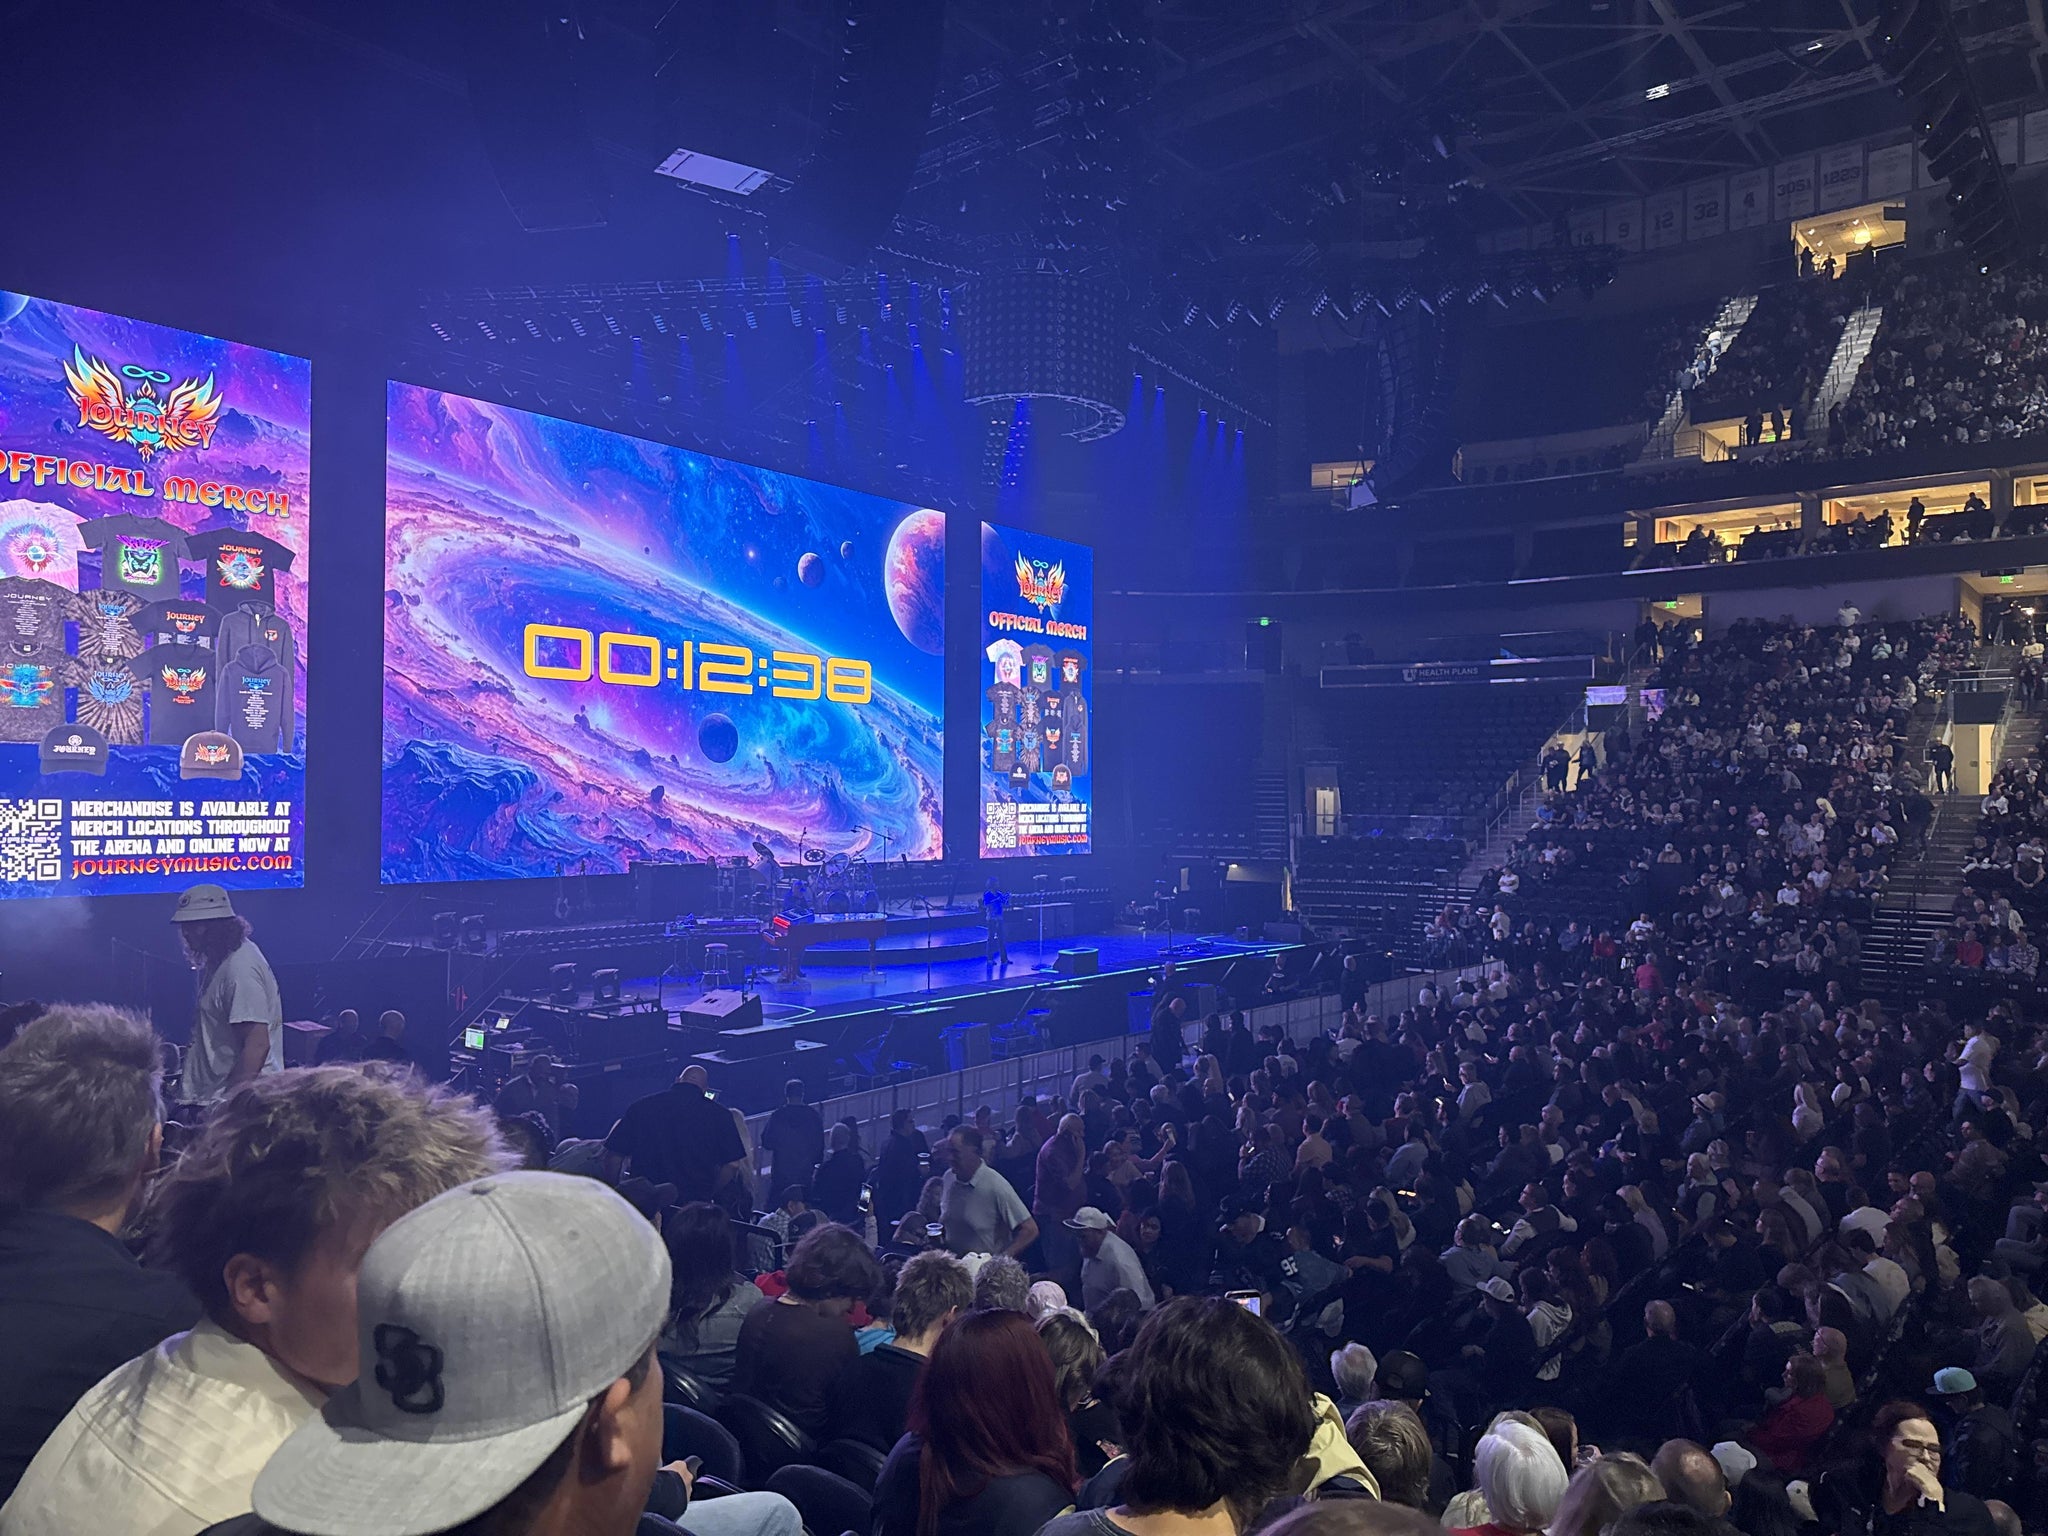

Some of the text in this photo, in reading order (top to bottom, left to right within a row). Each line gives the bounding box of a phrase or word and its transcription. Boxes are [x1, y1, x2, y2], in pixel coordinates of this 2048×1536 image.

[1693, 200, 1719, 221] 32
[1653, 211, 1674, 232] 12
[76, 396, 217, 449] JOURNEY
[164, 475, 290, 518] MERCH
[3, 593, 52, 601] JOURNEY
[166, 611, 205, 624] JOURNEY
[989, 611, 1087, 640] OFFICIAL MERCH
[524, 623, 872, 704] 00:12:38
[1419, 667, 1450, 677] HEALTH
[1451, 666, 1479, 676] PLANS
[71, 801, 291, 817] MERCHANDISE IS AVAILABLE AT
[71, 819, 291, 837] MERCH LOCATIONS THROUGHOUT
[71, 837, 290, 856] THE ARENA AND ONLINE NOW AT
[71, 855, 292, 879] JOURNEYMUSIC.COM
